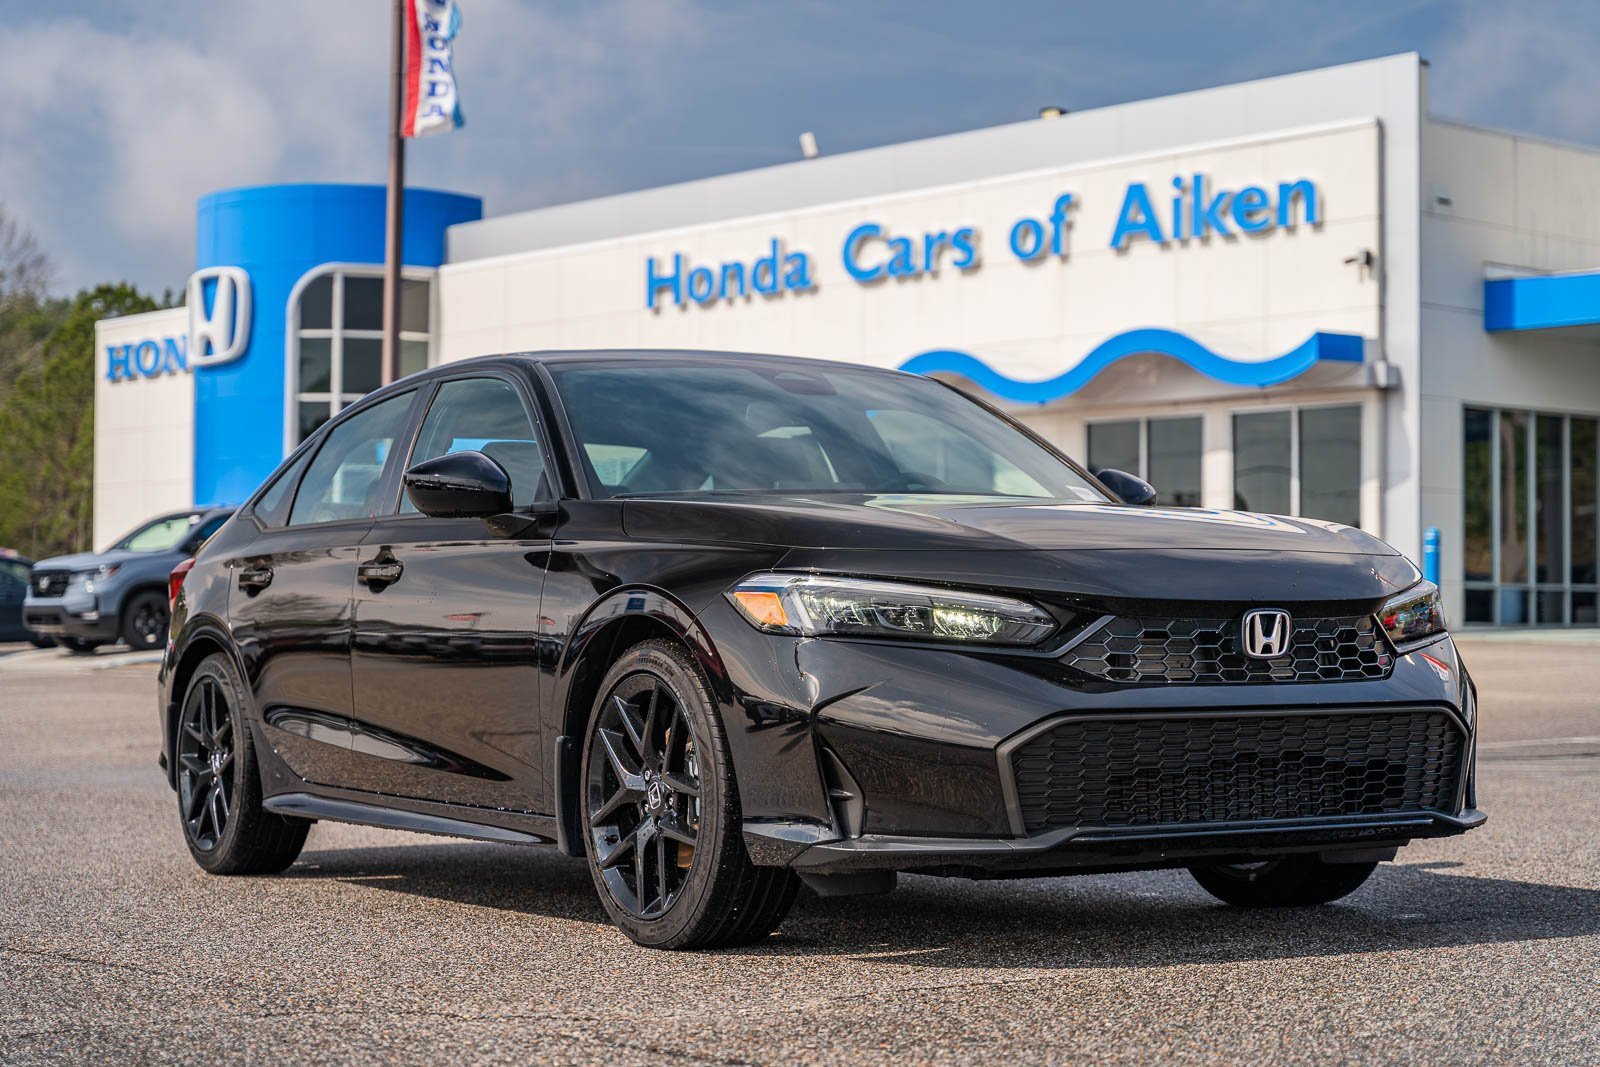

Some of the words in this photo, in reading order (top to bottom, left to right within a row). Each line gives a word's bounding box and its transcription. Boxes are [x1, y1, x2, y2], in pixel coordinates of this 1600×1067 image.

[645, 237, 812, 309] Honda
[842, 222, 976, 282] Cars
[1009, 193, 1074, 262] of
[1109, 173, 1317, 250] Aiken
